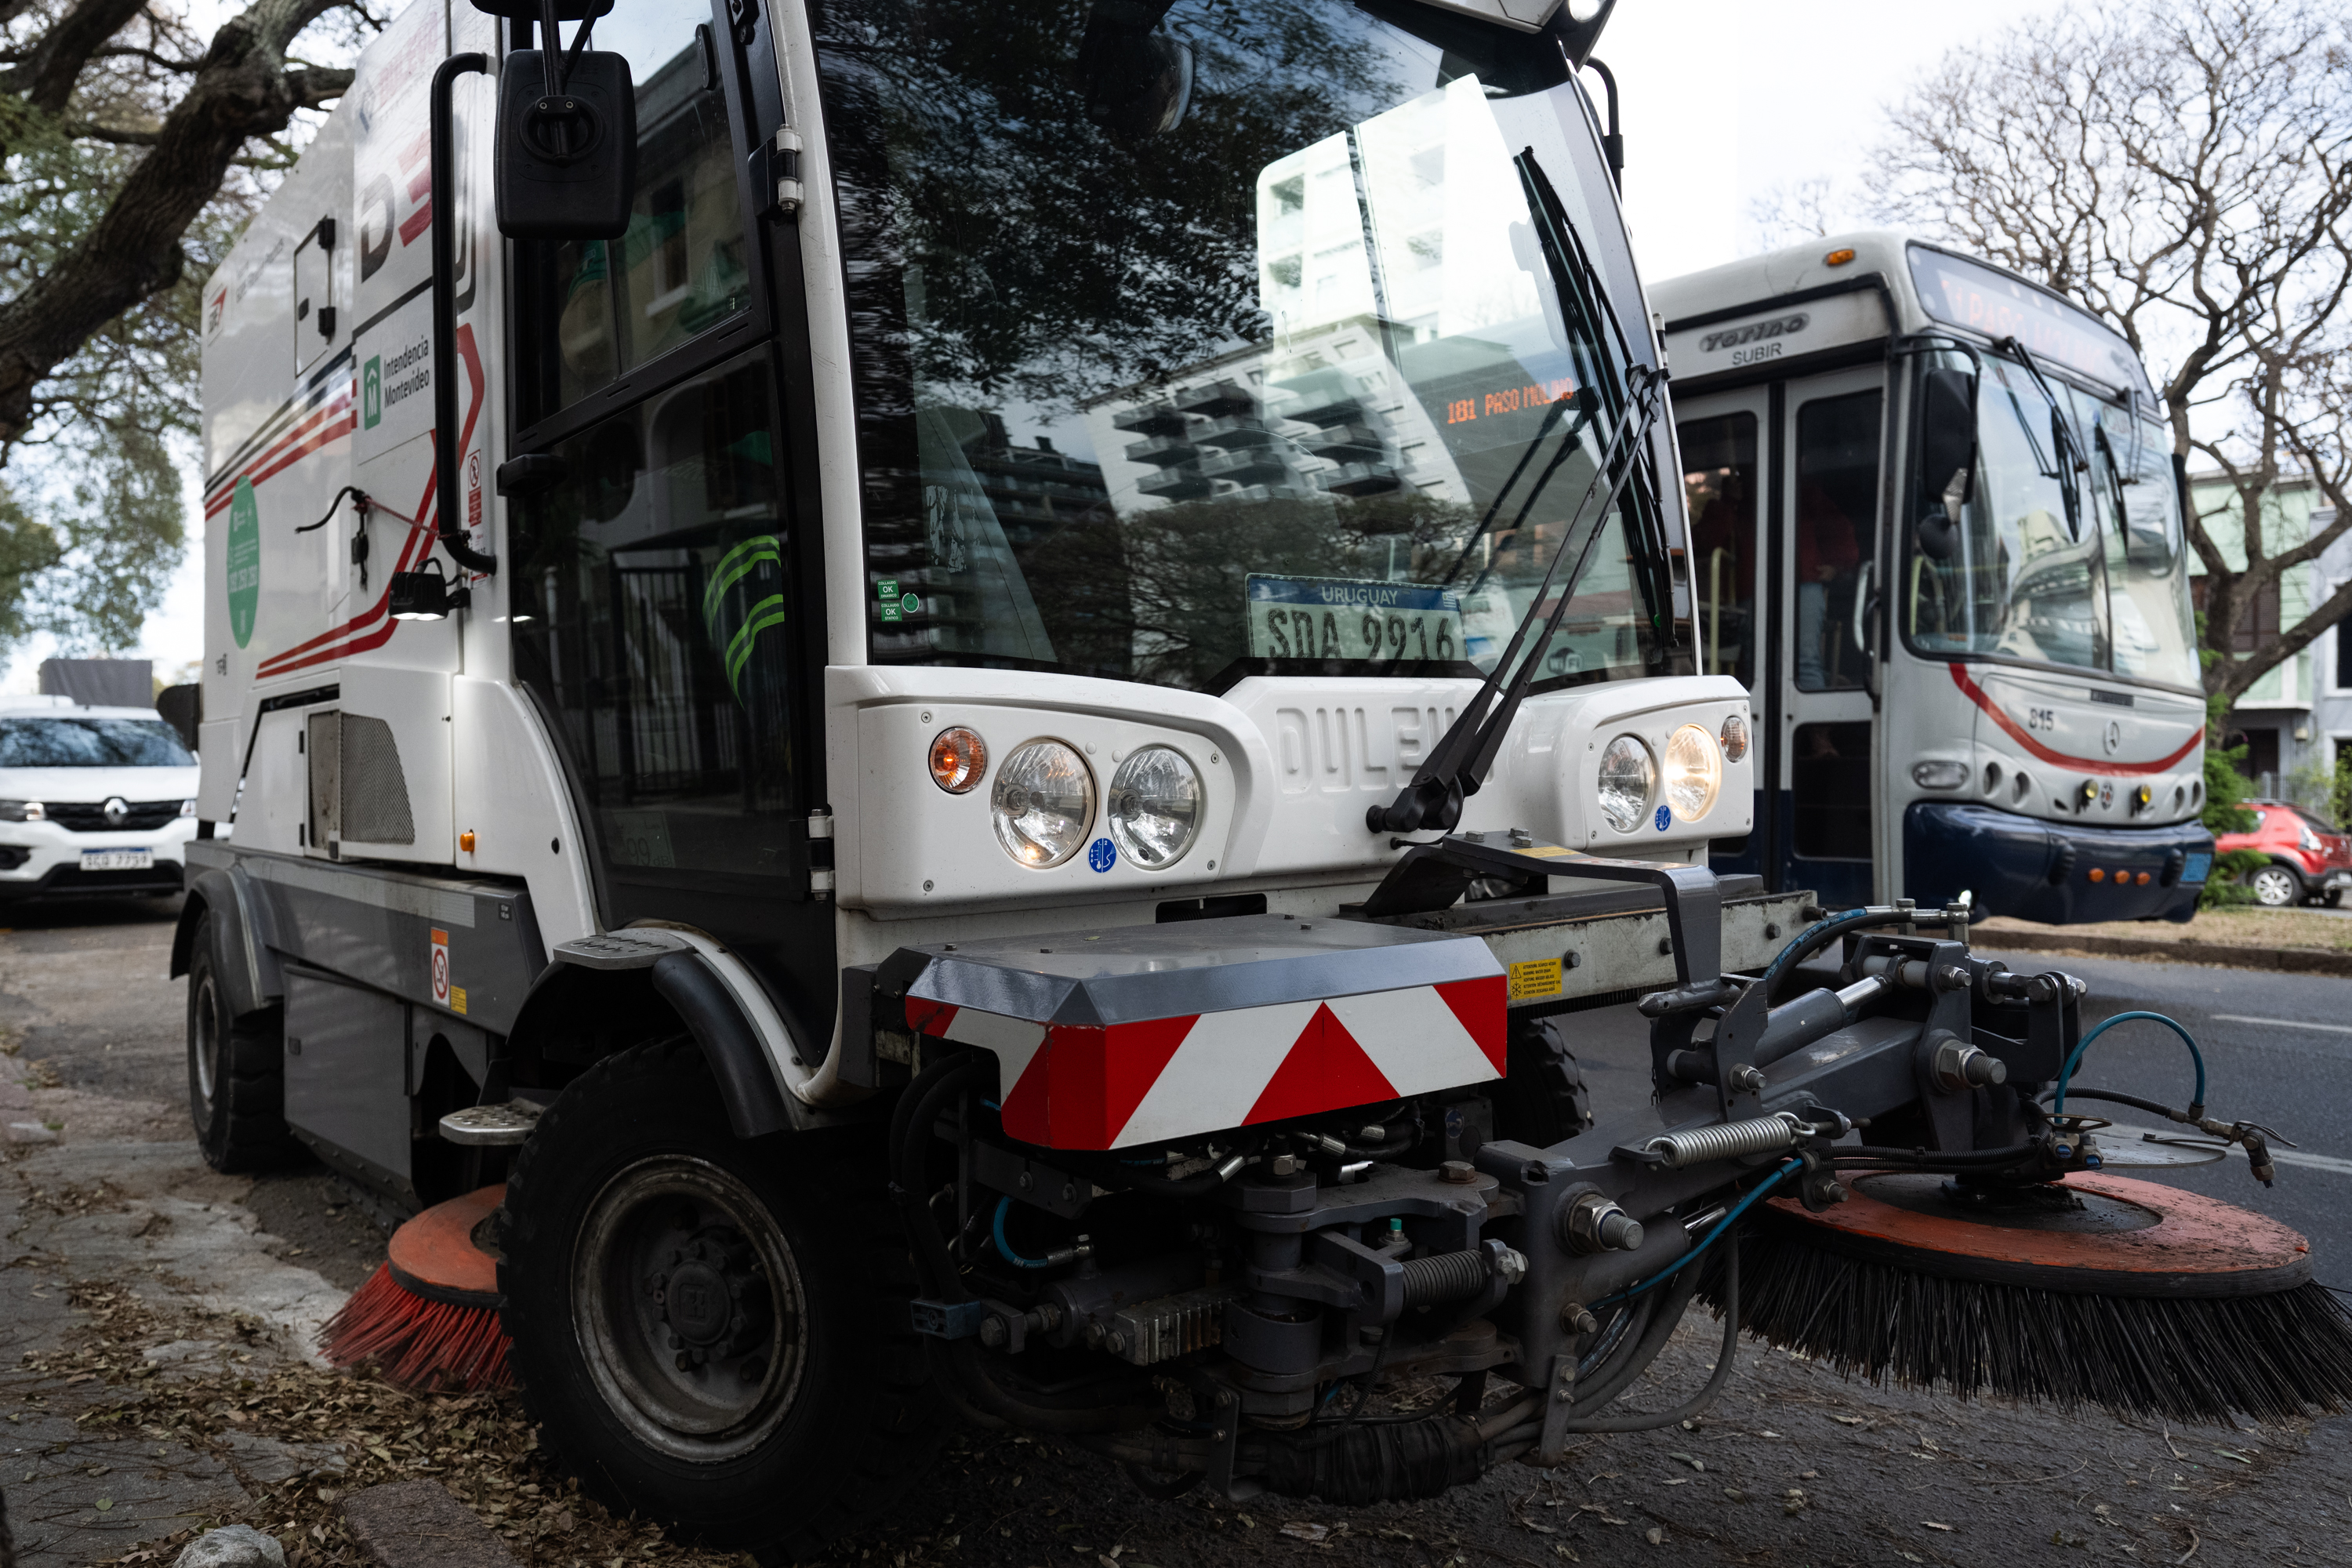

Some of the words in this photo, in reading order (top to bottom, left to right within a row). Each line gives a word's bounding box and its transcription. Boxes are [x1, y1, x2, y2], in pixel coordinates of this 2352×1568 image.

[1704, 315, 1805, 353] Torino
[383, 334, 429, 381] Intendencia
[1731, 343, 1782, 366] SUBIR
[384, 366, 430, 408] Montevideo
[1447, 398, 1477, 424] 181
[1484, 388, 1519, 416] PASO
[1321, 586, 1398, 605] URUGUAY
[1360, 613, 1456, 661] 9916
[2028, 708, 2054, 731] 815
